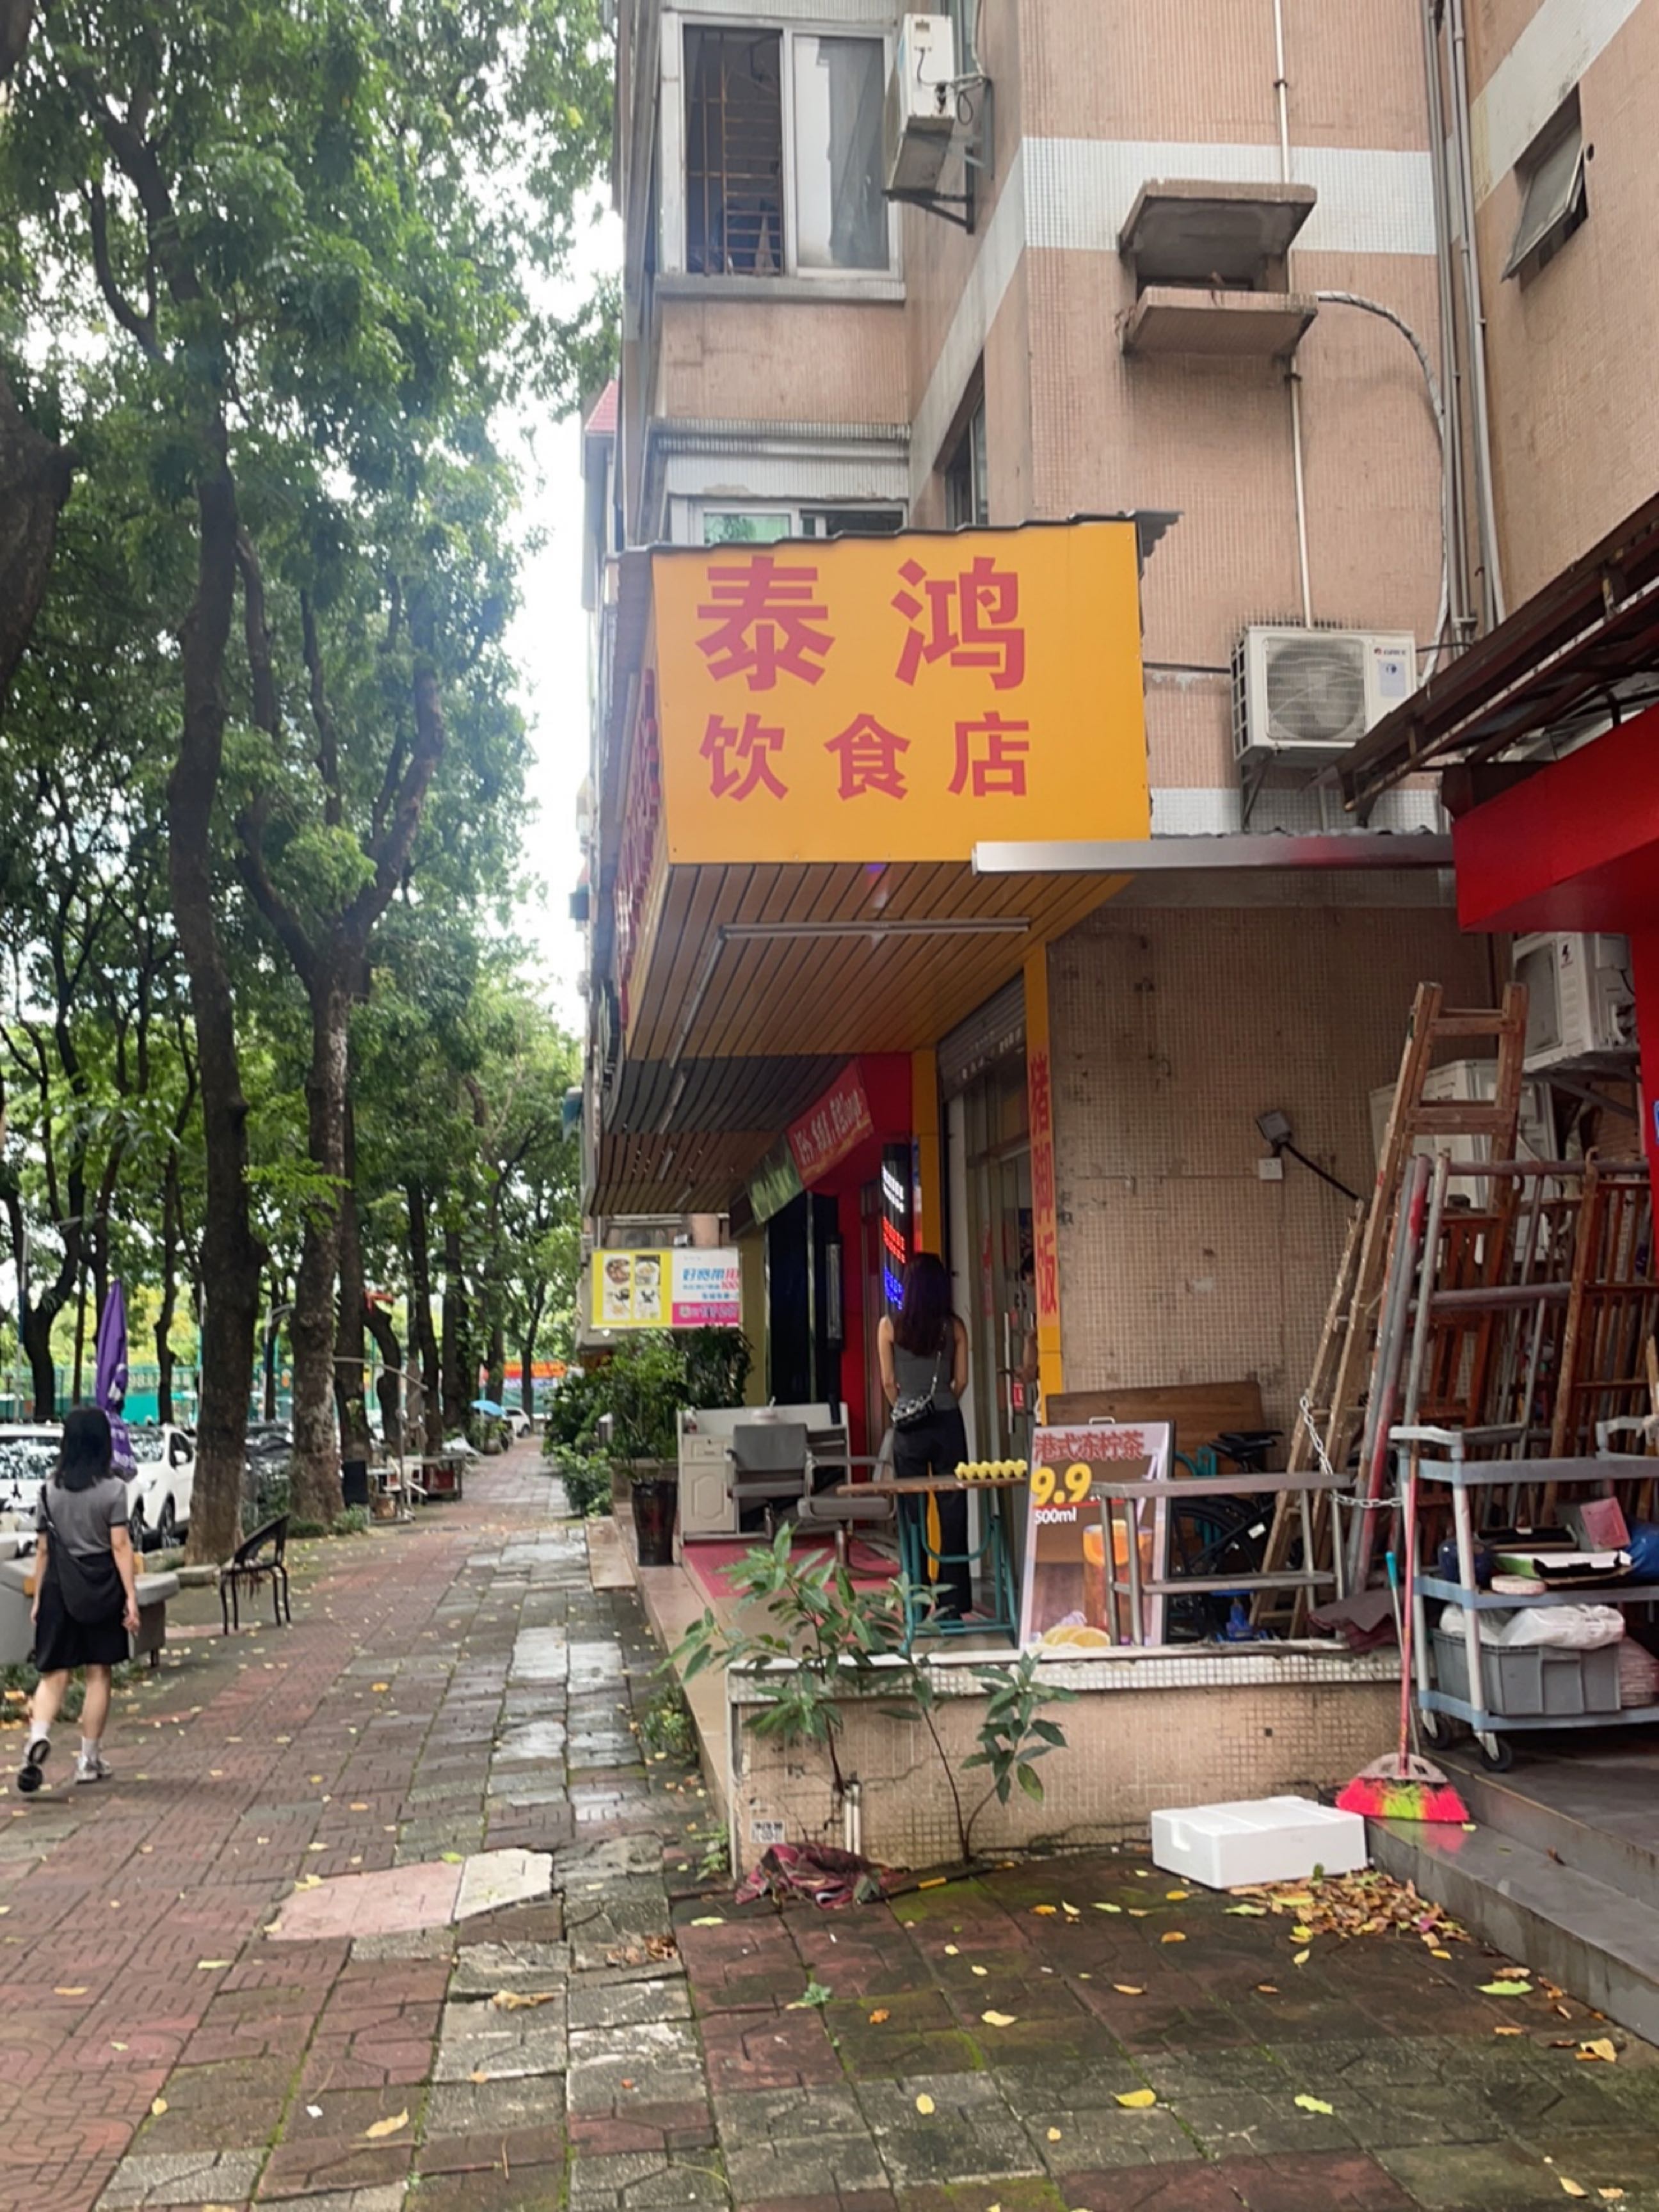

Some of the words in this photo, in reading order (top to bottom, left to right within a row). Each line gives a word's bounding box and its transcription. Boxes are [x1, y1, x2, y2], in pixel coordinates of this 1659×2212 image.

[695, 555, 1025, 691] 泰鸿
[699, 710, 1030, 803] 饮食店
[1034, 1429, 1144, 1462] 港式冻柠茶
[1031, 1462, 1092, 1507] 9.9
